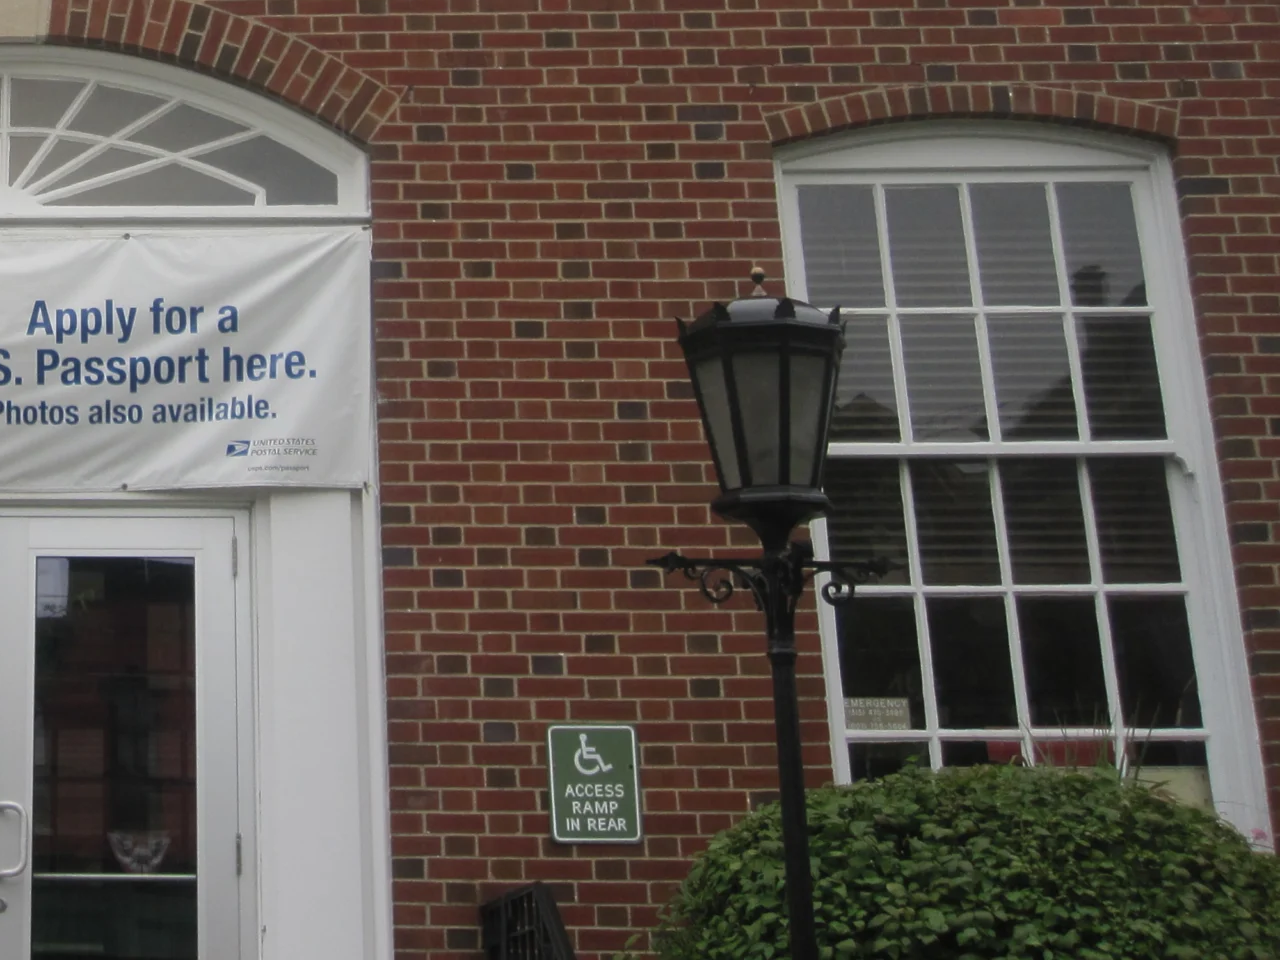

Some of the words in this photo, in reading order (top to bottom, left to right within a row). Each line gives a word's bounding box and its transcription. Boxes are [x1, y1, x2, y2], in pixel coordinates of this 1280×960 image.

[26, 298, 137, 344] Apply
[149, 297, 204, 334] for
[217, 304, 239, 334] a
[36, 347, 210, 393] Passport
[222, 346, 317, 383] here.
[88, 398, 143, 425] also
[152, 394, 278, 424] available.
[253, 438, 285, 447] UNITED
[285, 438, 316, 446] STATES
[251, 448, 281, 456] POSTAL
[283, 448, 318, 456] SERVICE
[844, 698, 907, 708] EMERGENCY
[565, 784, 624, 798] ACCESS
[572, 801, 618, 814] RAMP
[566, 818, 580, 831] IN
[587, 818, 627, 831] REAR
